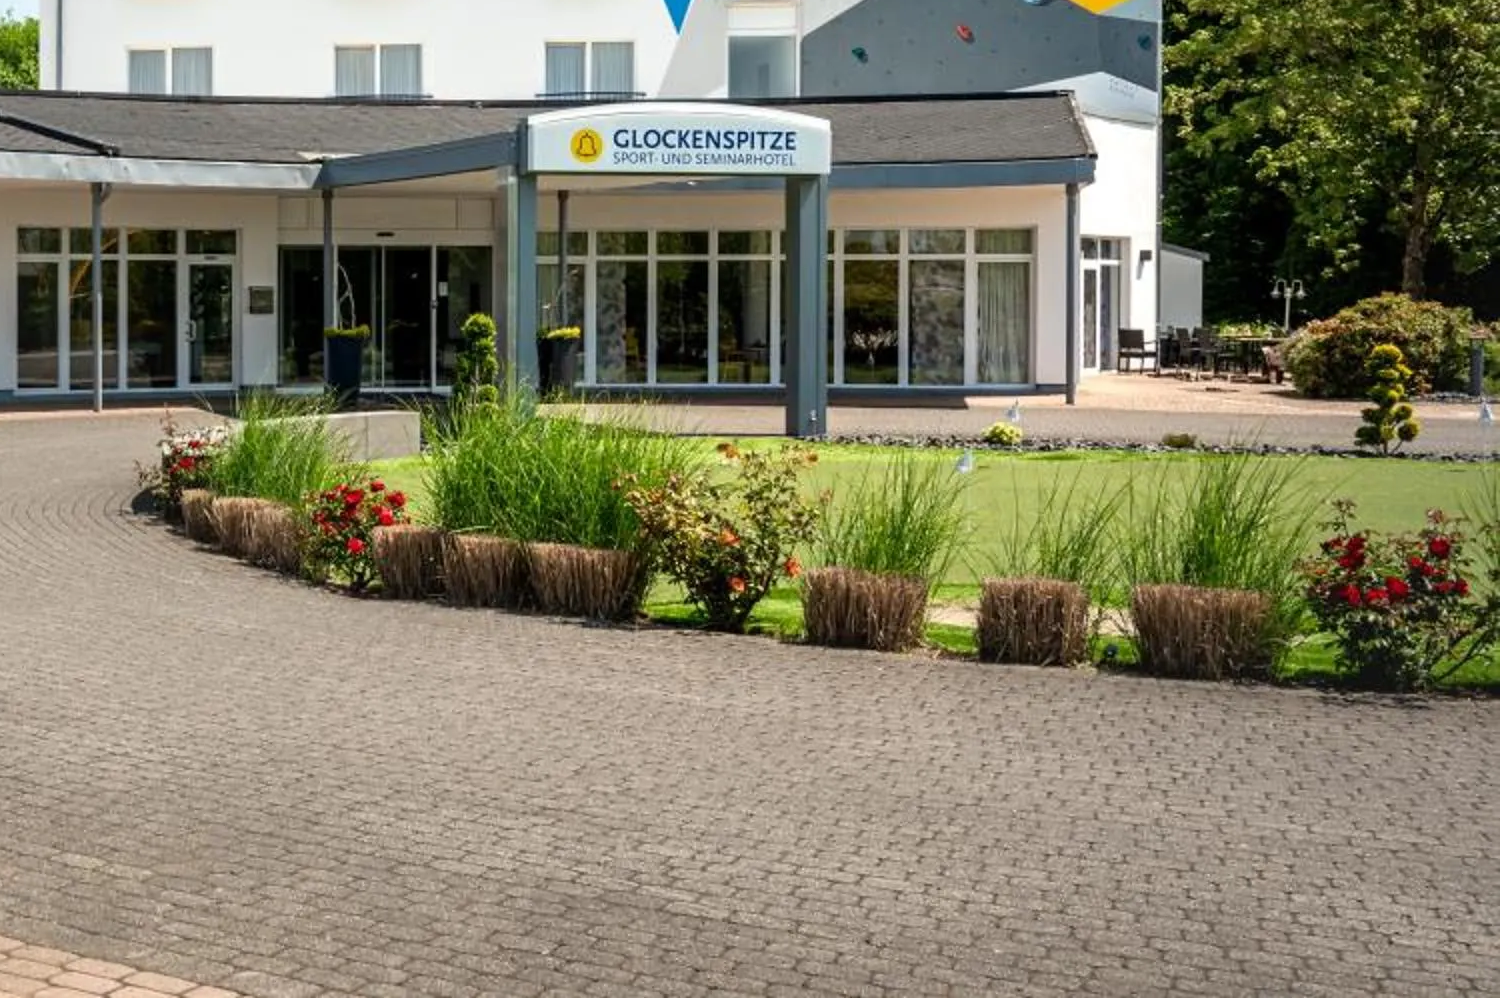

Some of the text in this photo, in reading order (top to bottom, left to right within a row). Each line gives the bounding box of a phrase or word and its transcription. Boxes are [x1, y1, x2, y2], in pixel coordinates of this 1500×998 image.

[613, 129, 797, 151] GLOCKENSPITZE
[613, 152, 796, 167] SPORT- UND SEMINARHOTEL
